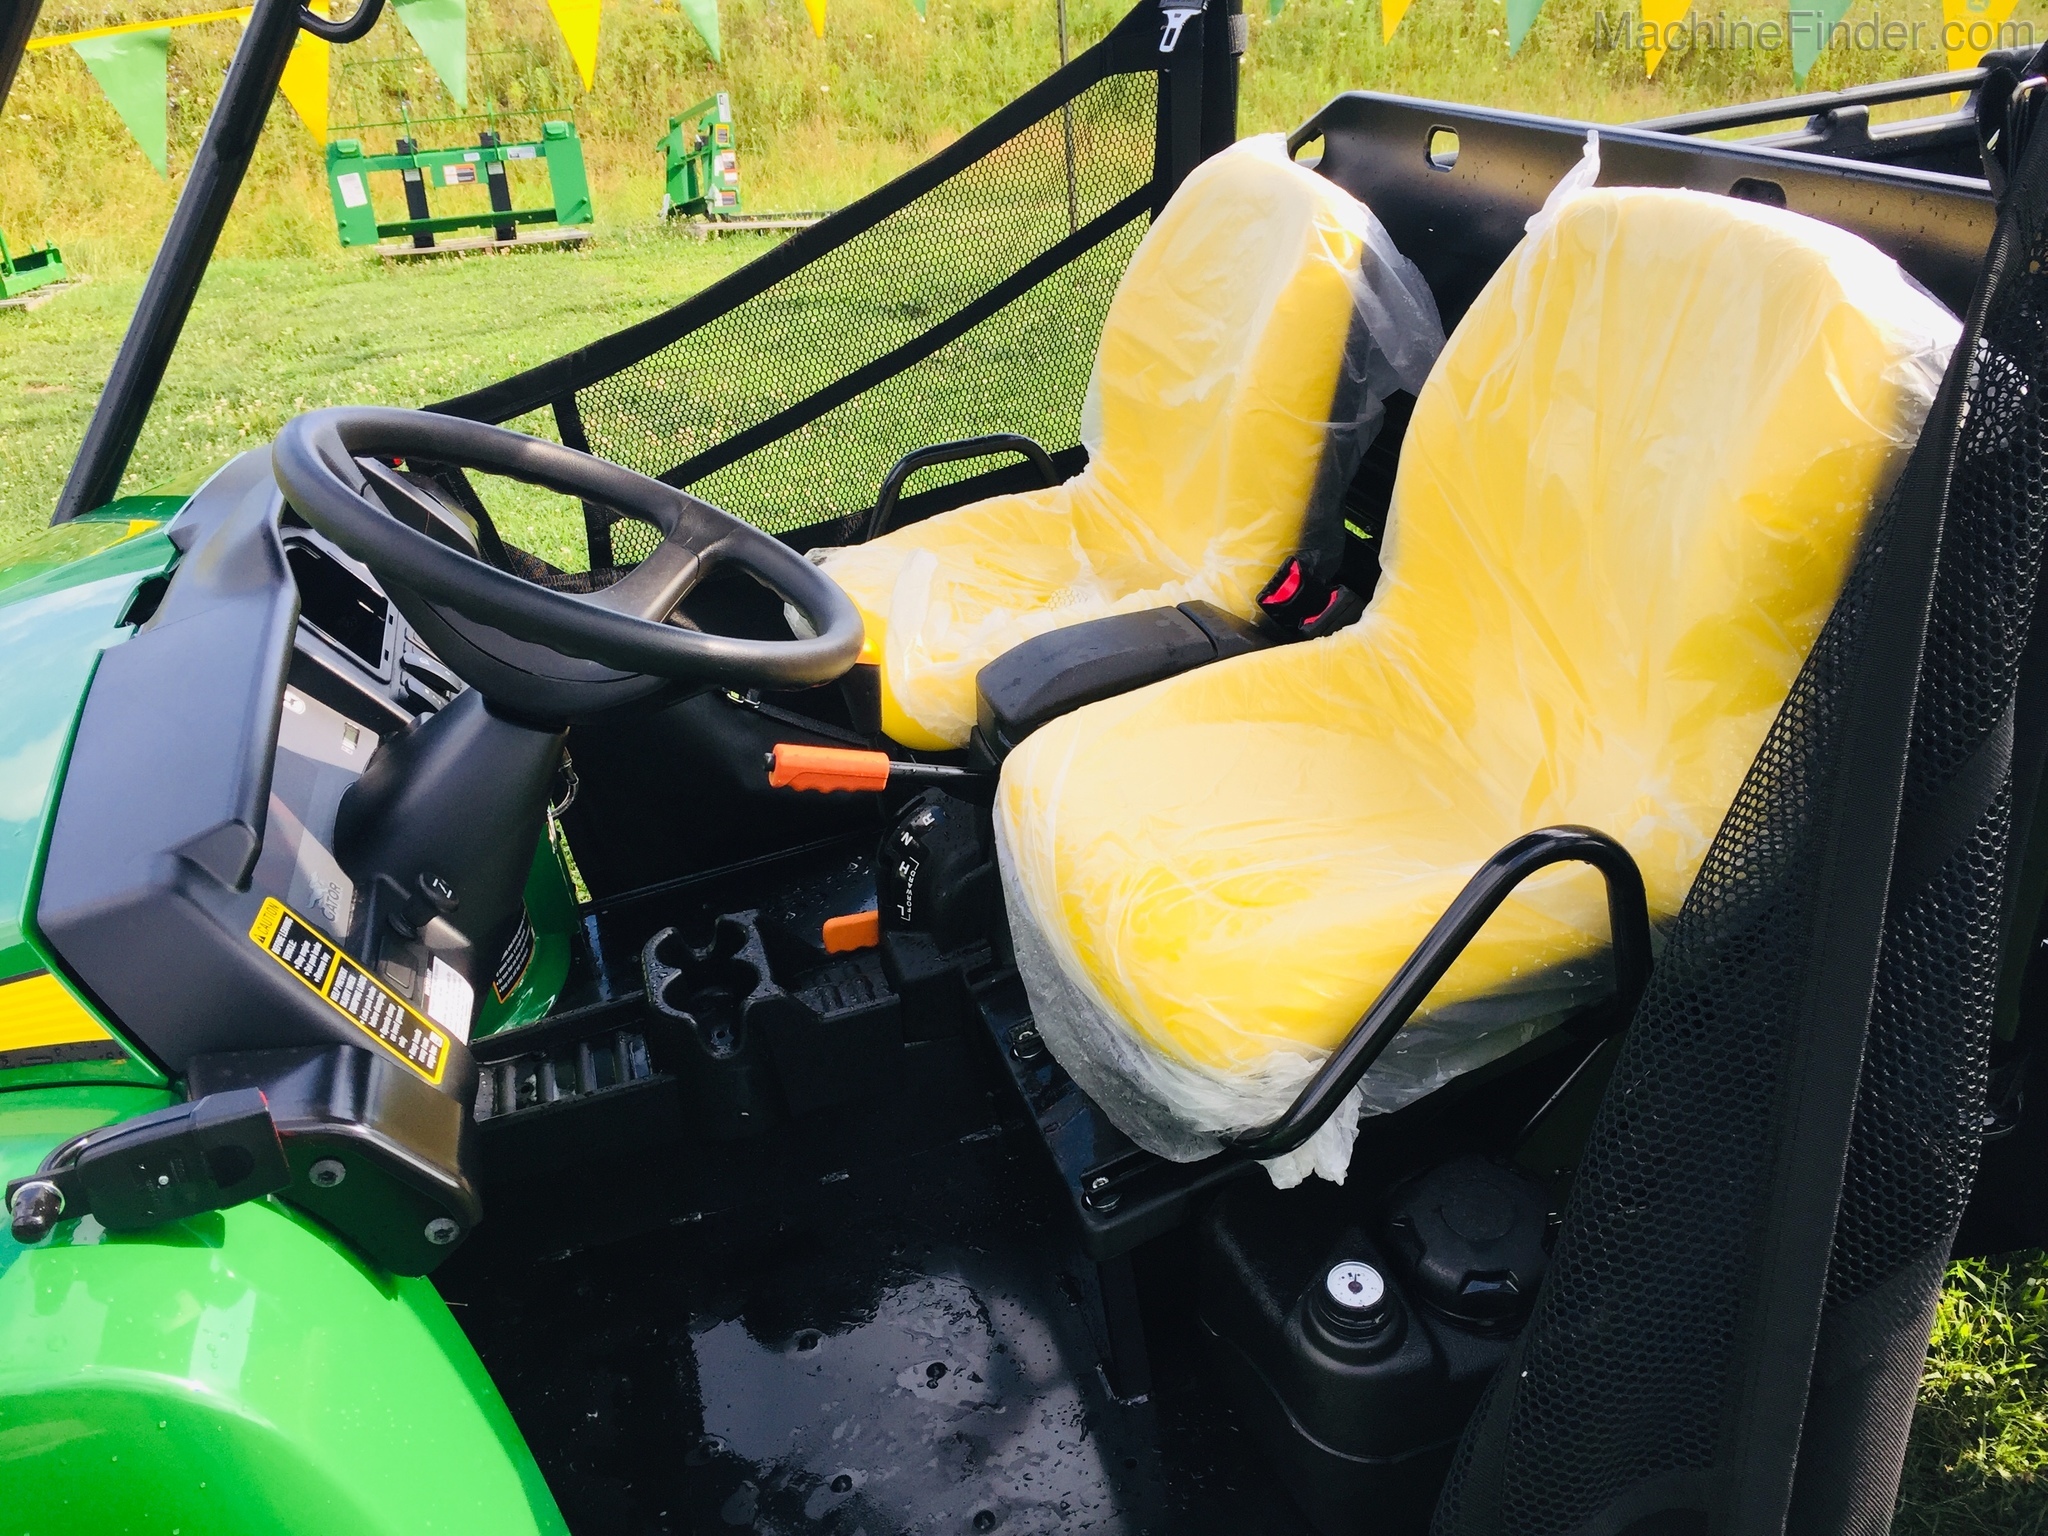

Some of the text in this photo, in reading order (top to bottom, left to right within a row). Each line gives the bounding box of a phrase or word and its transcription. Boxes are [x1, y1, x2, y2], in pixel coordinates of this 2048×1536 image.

[922, 813, 935, 826] R
[900, 832, 913, 846] N
[899, 861, 910, 874] H
[905, 870, 916, 913] FORWARD
[321, 881, 342, 922] GATOR
[897, 904, 904, 916] L
[257, 902, 280, 936] CAUTION
